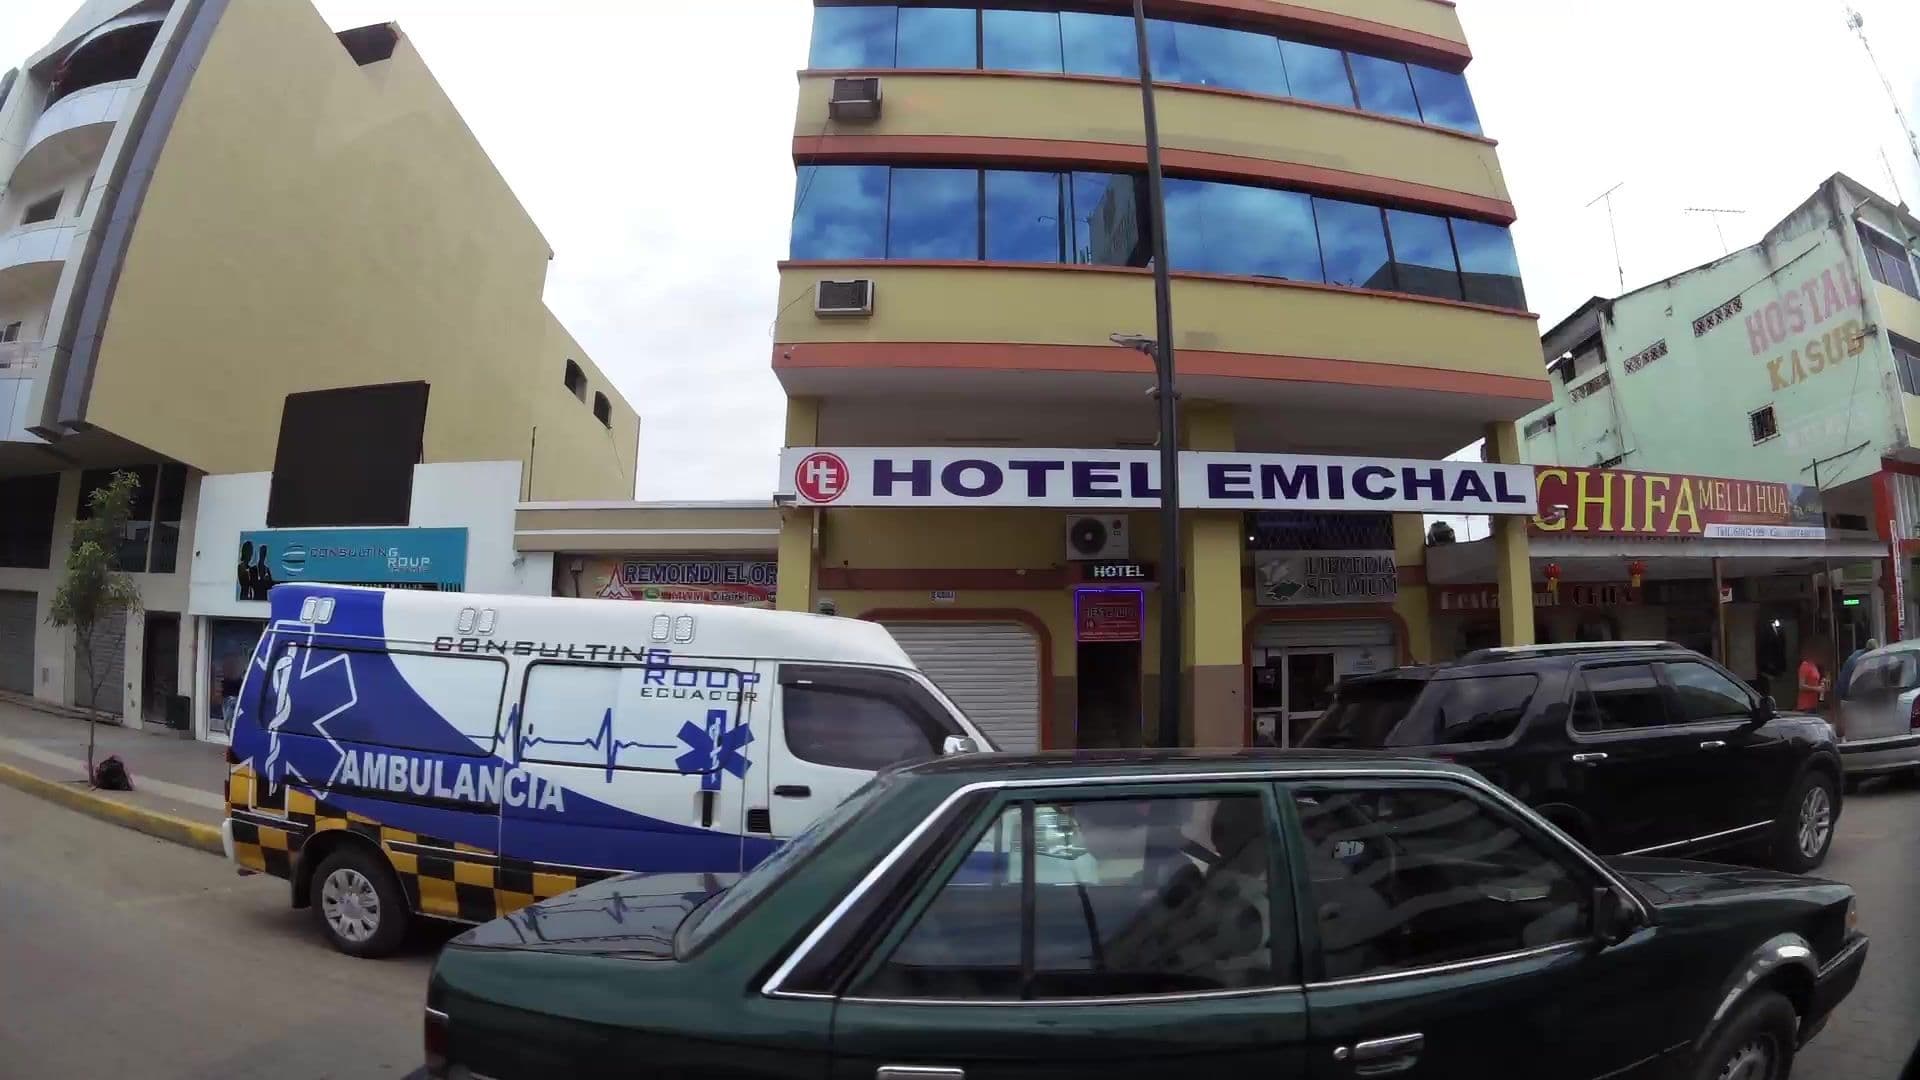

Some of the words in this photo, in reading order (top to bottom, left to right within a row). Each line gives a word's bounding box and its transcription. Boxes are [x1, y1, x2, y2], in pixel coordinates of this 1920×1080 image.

[1745, 261, 1863, 356] HOSTAL
[873, 459, 1162, 499] HOTEL
[1207, 464, 1527, 503] EMICHAL
[1532, 469, 1702, 533] CHIFA
[1699, 480, 1731, 511] MEI
[1737, 483, 1751, 512] LI
[1756, 484, 1788, 514] HUA
[624, 563, 720, 584] REMOINDI
[1094, 565, 1145, 577] HOTEL
[641, 687, 758, 702] ECUADOR
[341, 751, 564, 812] AMBULANCIA
